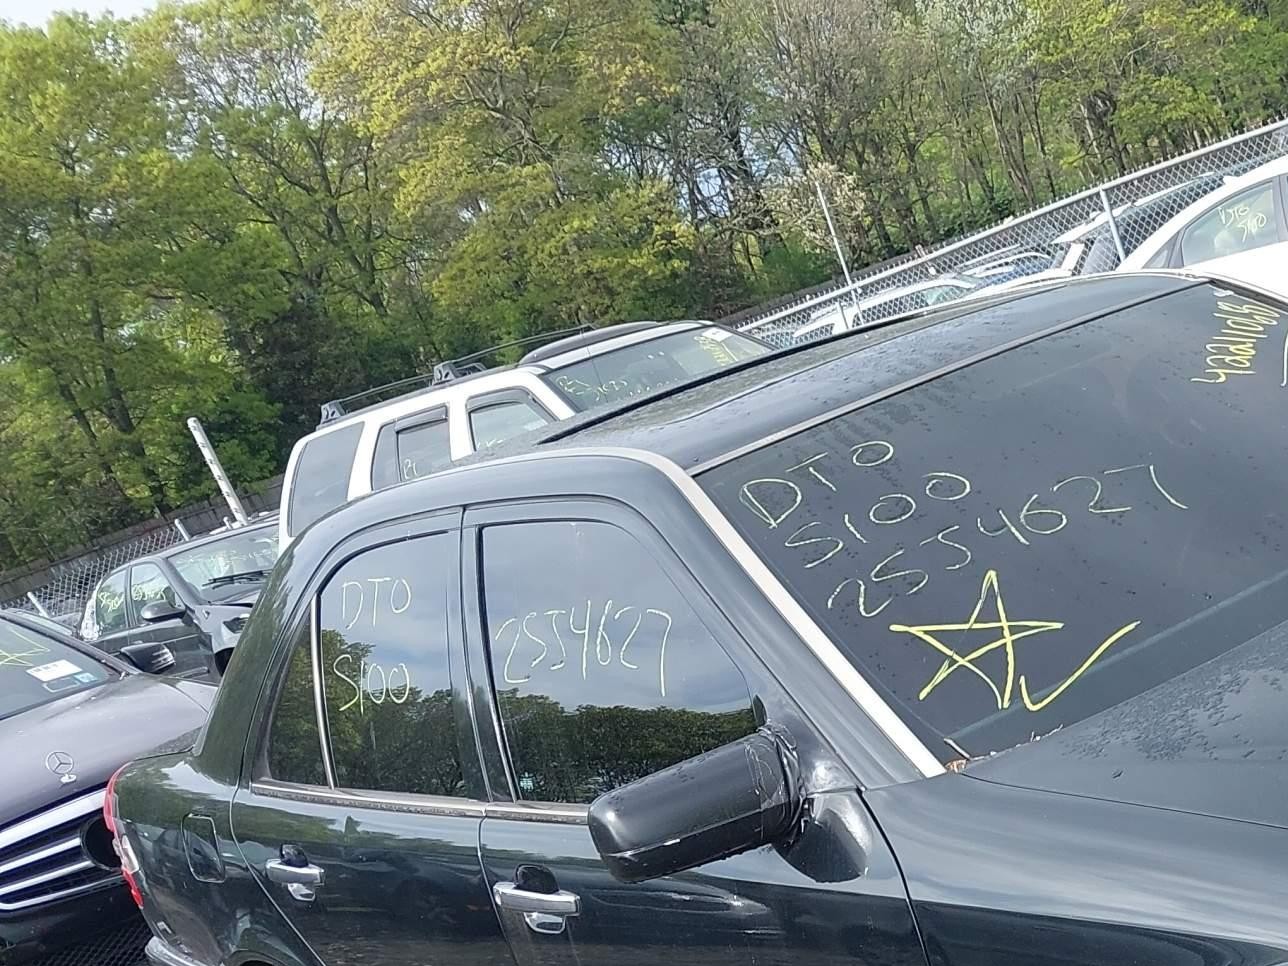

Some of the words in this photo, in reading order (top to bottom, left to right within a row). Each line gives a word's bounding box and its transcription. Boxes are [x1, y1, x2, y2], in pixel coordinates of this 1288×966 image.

[739, 441, 894, 529] DTO
[784, 472, 971, 568] S100
[341, 576, 412, 631] DTO
[332, 653, 411, 716] S100
